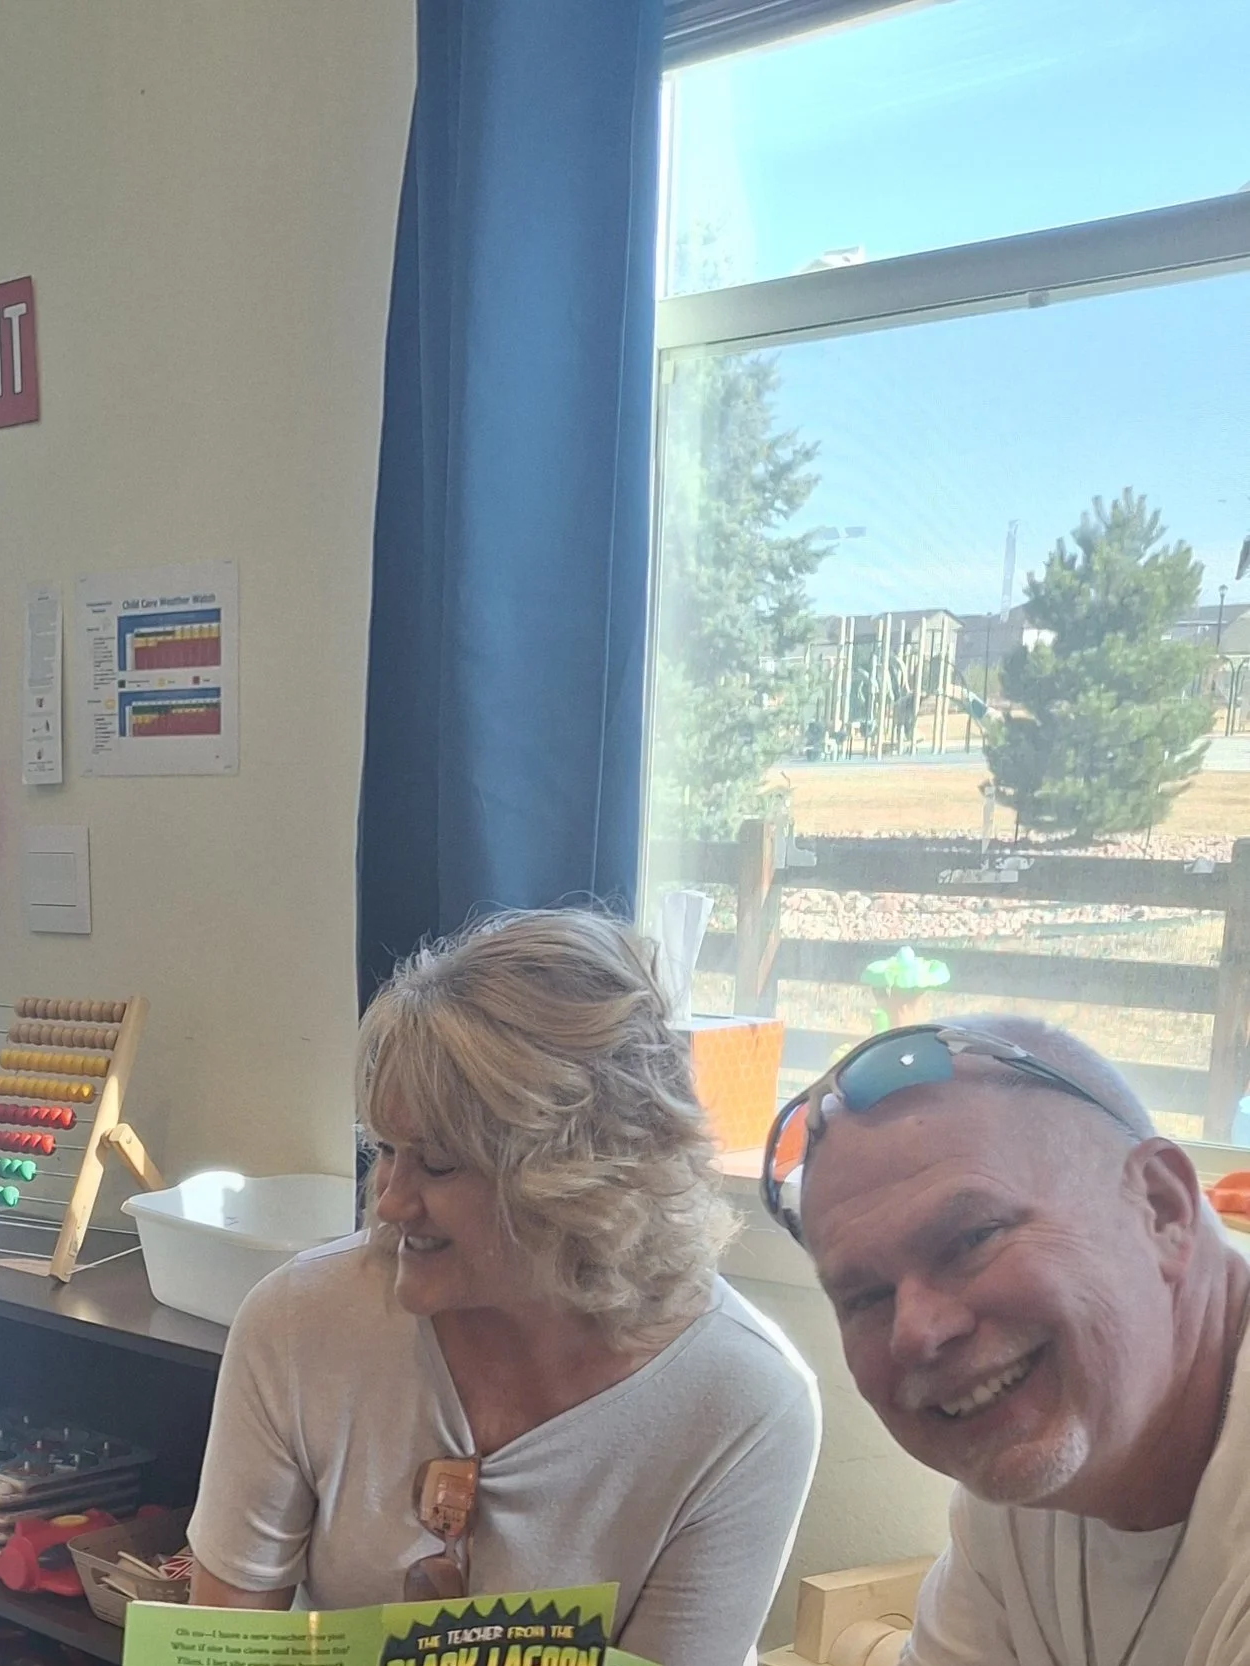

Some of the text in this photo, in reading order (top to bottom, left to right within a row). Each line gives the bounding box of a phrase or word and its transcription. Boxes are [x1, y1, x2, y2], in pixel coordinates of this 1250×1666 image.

[122, 600, 139, 610] Child
[141, 598, 158, 609] Care
[417, 1625, 575, 1650] THE TEACHER FROM THE
[171, 1641, 196, 1650] What
